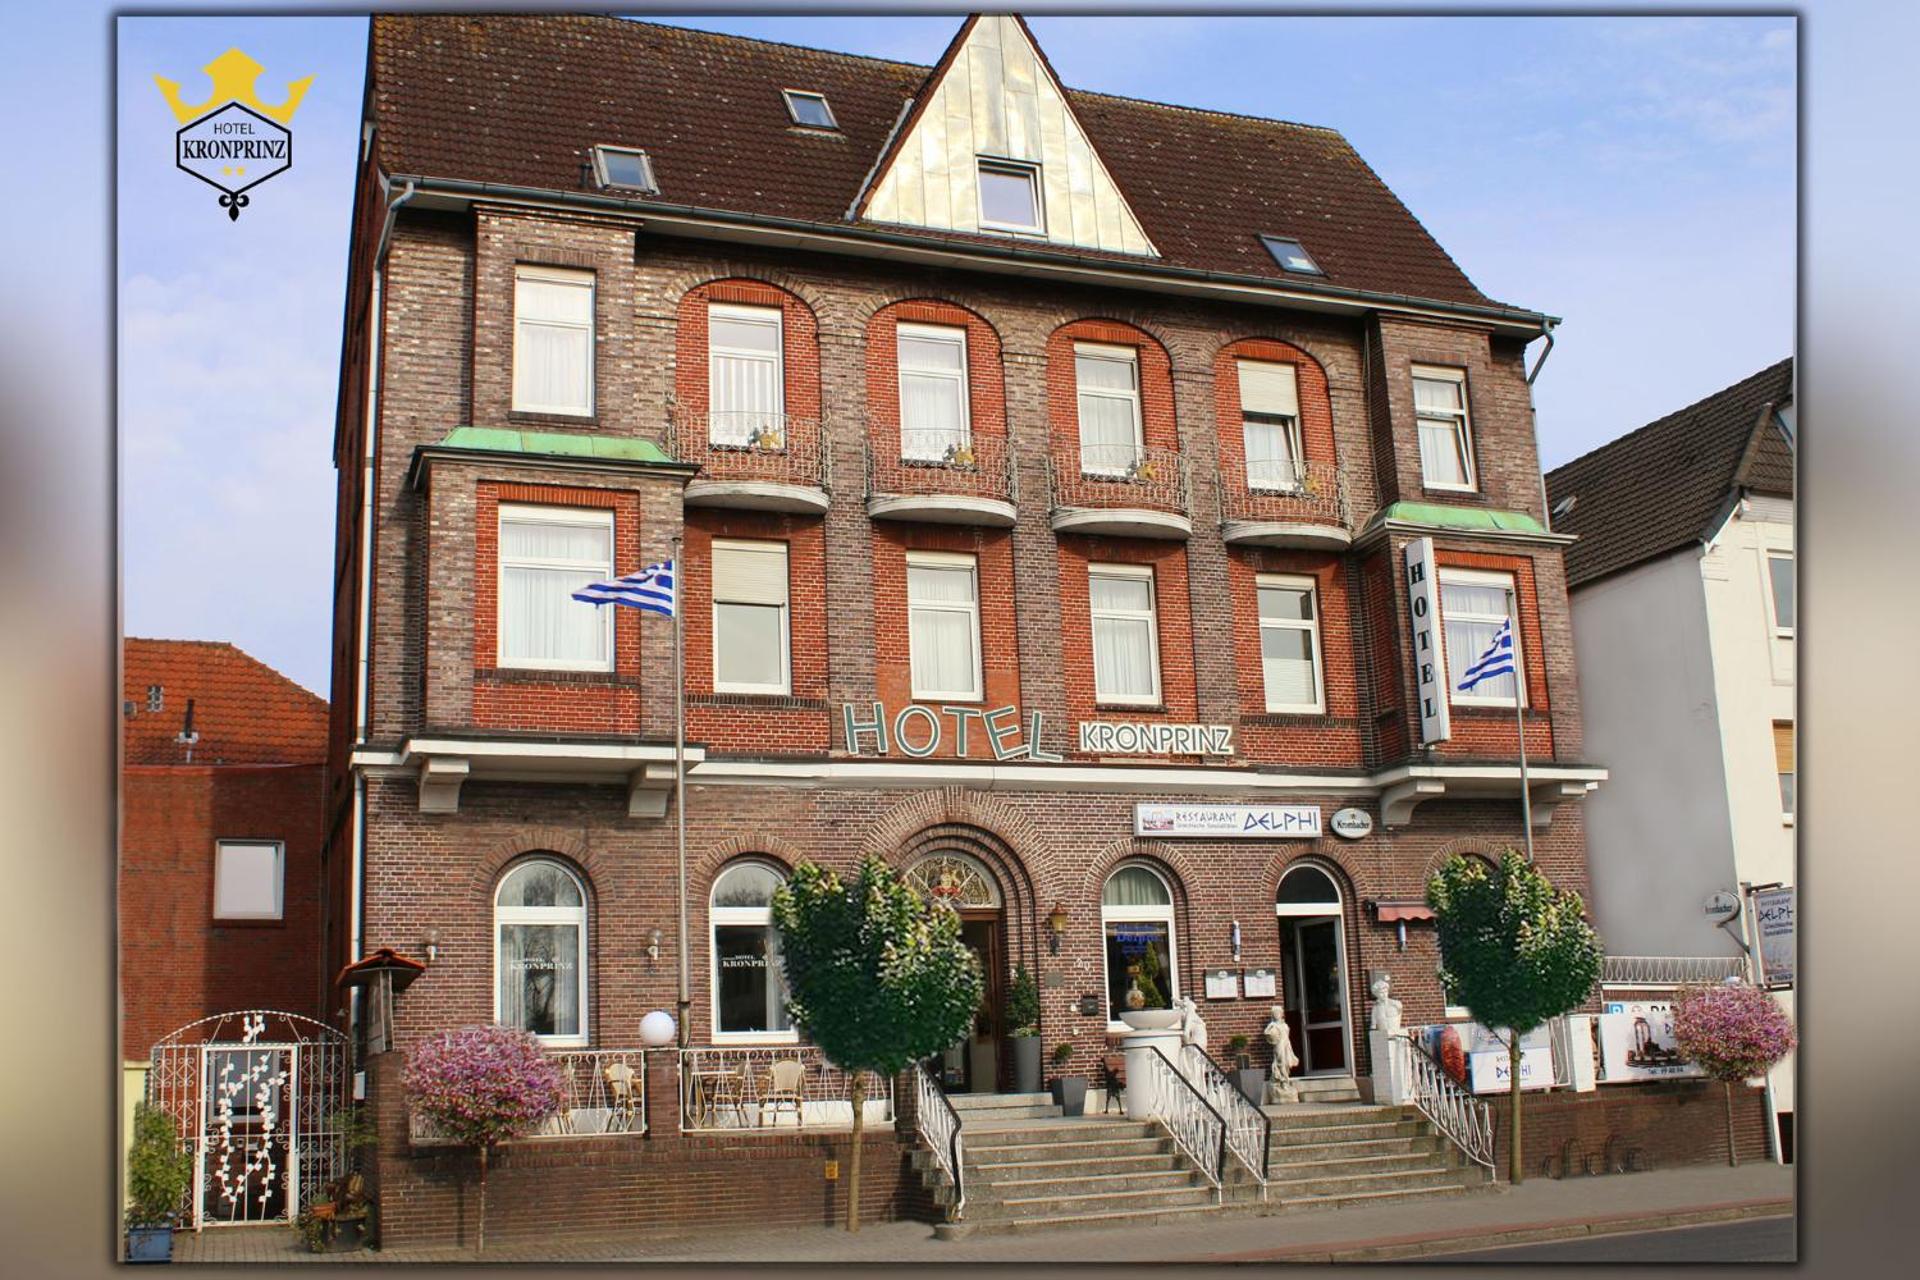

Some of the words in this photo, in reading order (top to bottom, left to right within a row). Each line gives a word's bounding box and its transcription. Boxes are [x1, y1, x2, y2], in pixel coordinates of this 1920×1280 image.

[1409, 561, 1437, 719] HOTEL
[842, 702, 1063, 762] HOTEL
[1080, 722, 1233, 754] KRONPRINZ
[1495, 1065, 1532, 1079] DEHI
